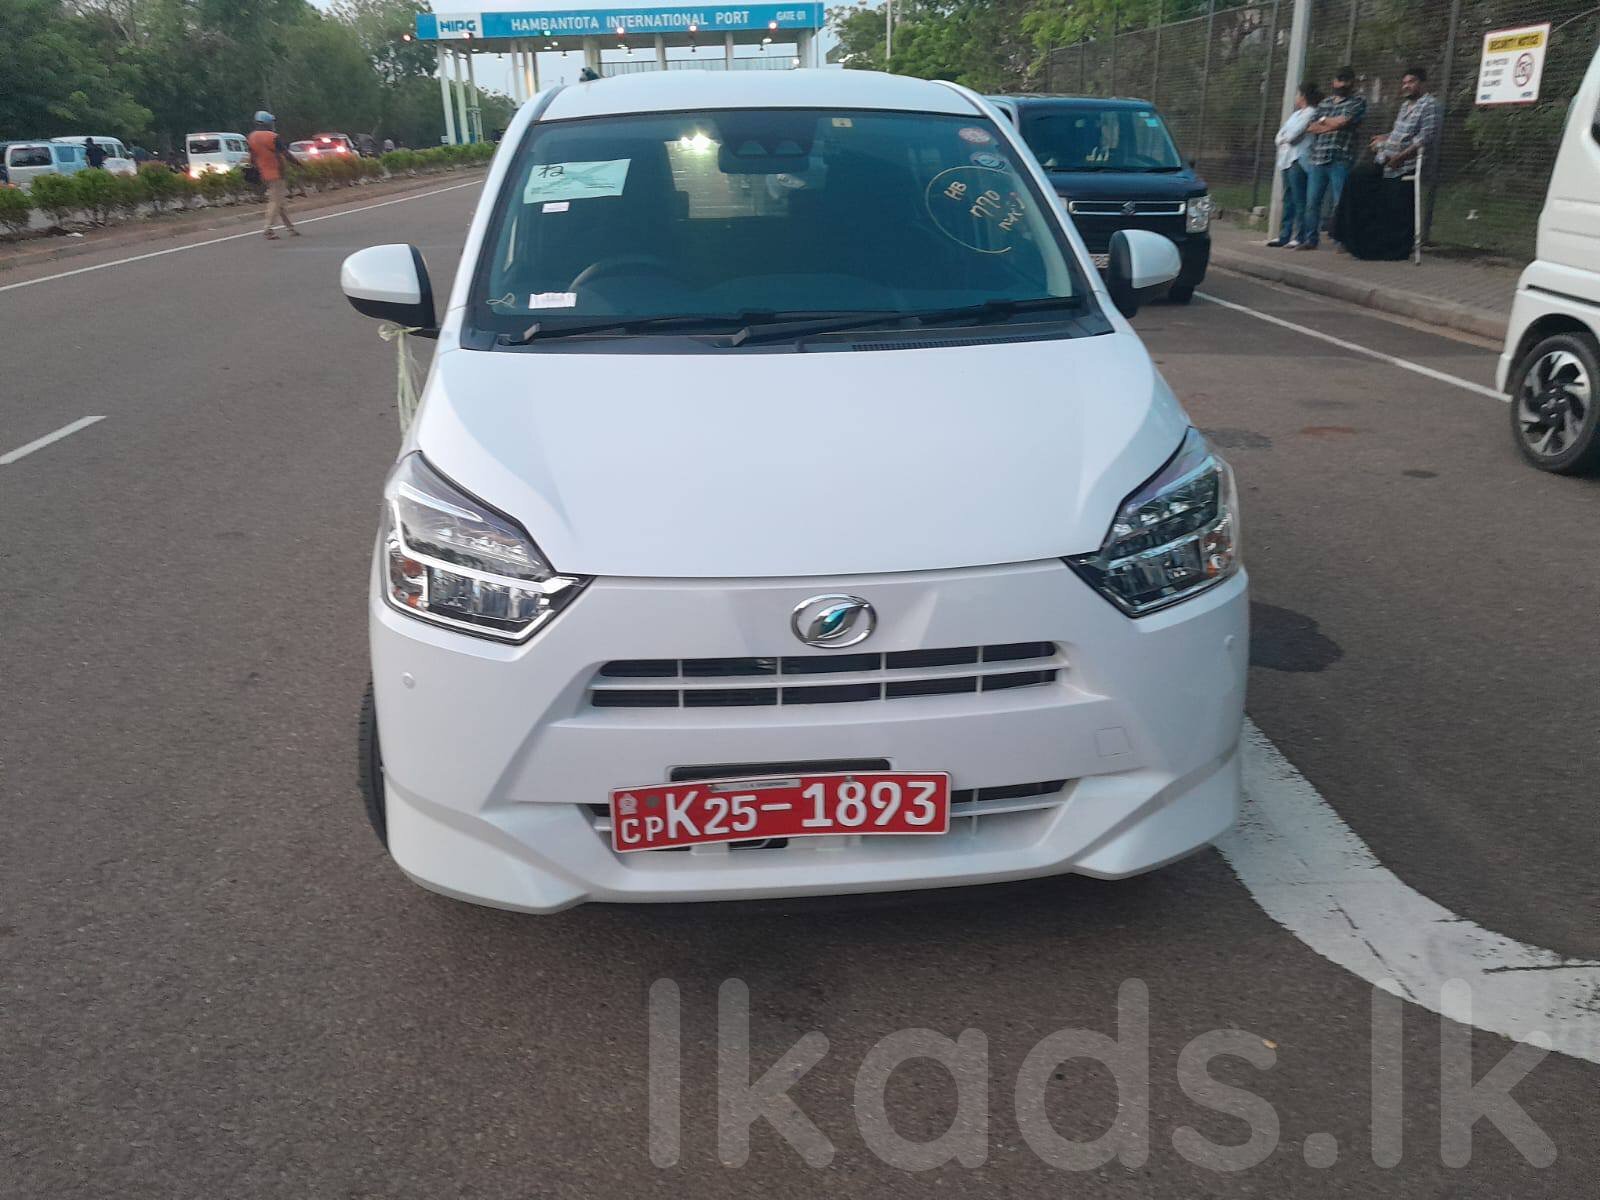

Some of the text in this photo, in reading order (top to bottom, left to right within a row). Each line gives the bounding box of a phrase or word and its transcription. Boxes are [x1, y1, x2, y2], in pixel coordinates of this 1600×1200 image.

[440, 20, 476, 32] HIPG
[511, 11, 749, 31] HAMBANTOTA INTERNATIONAL PORT
[621, 816, 664, 844] CP
